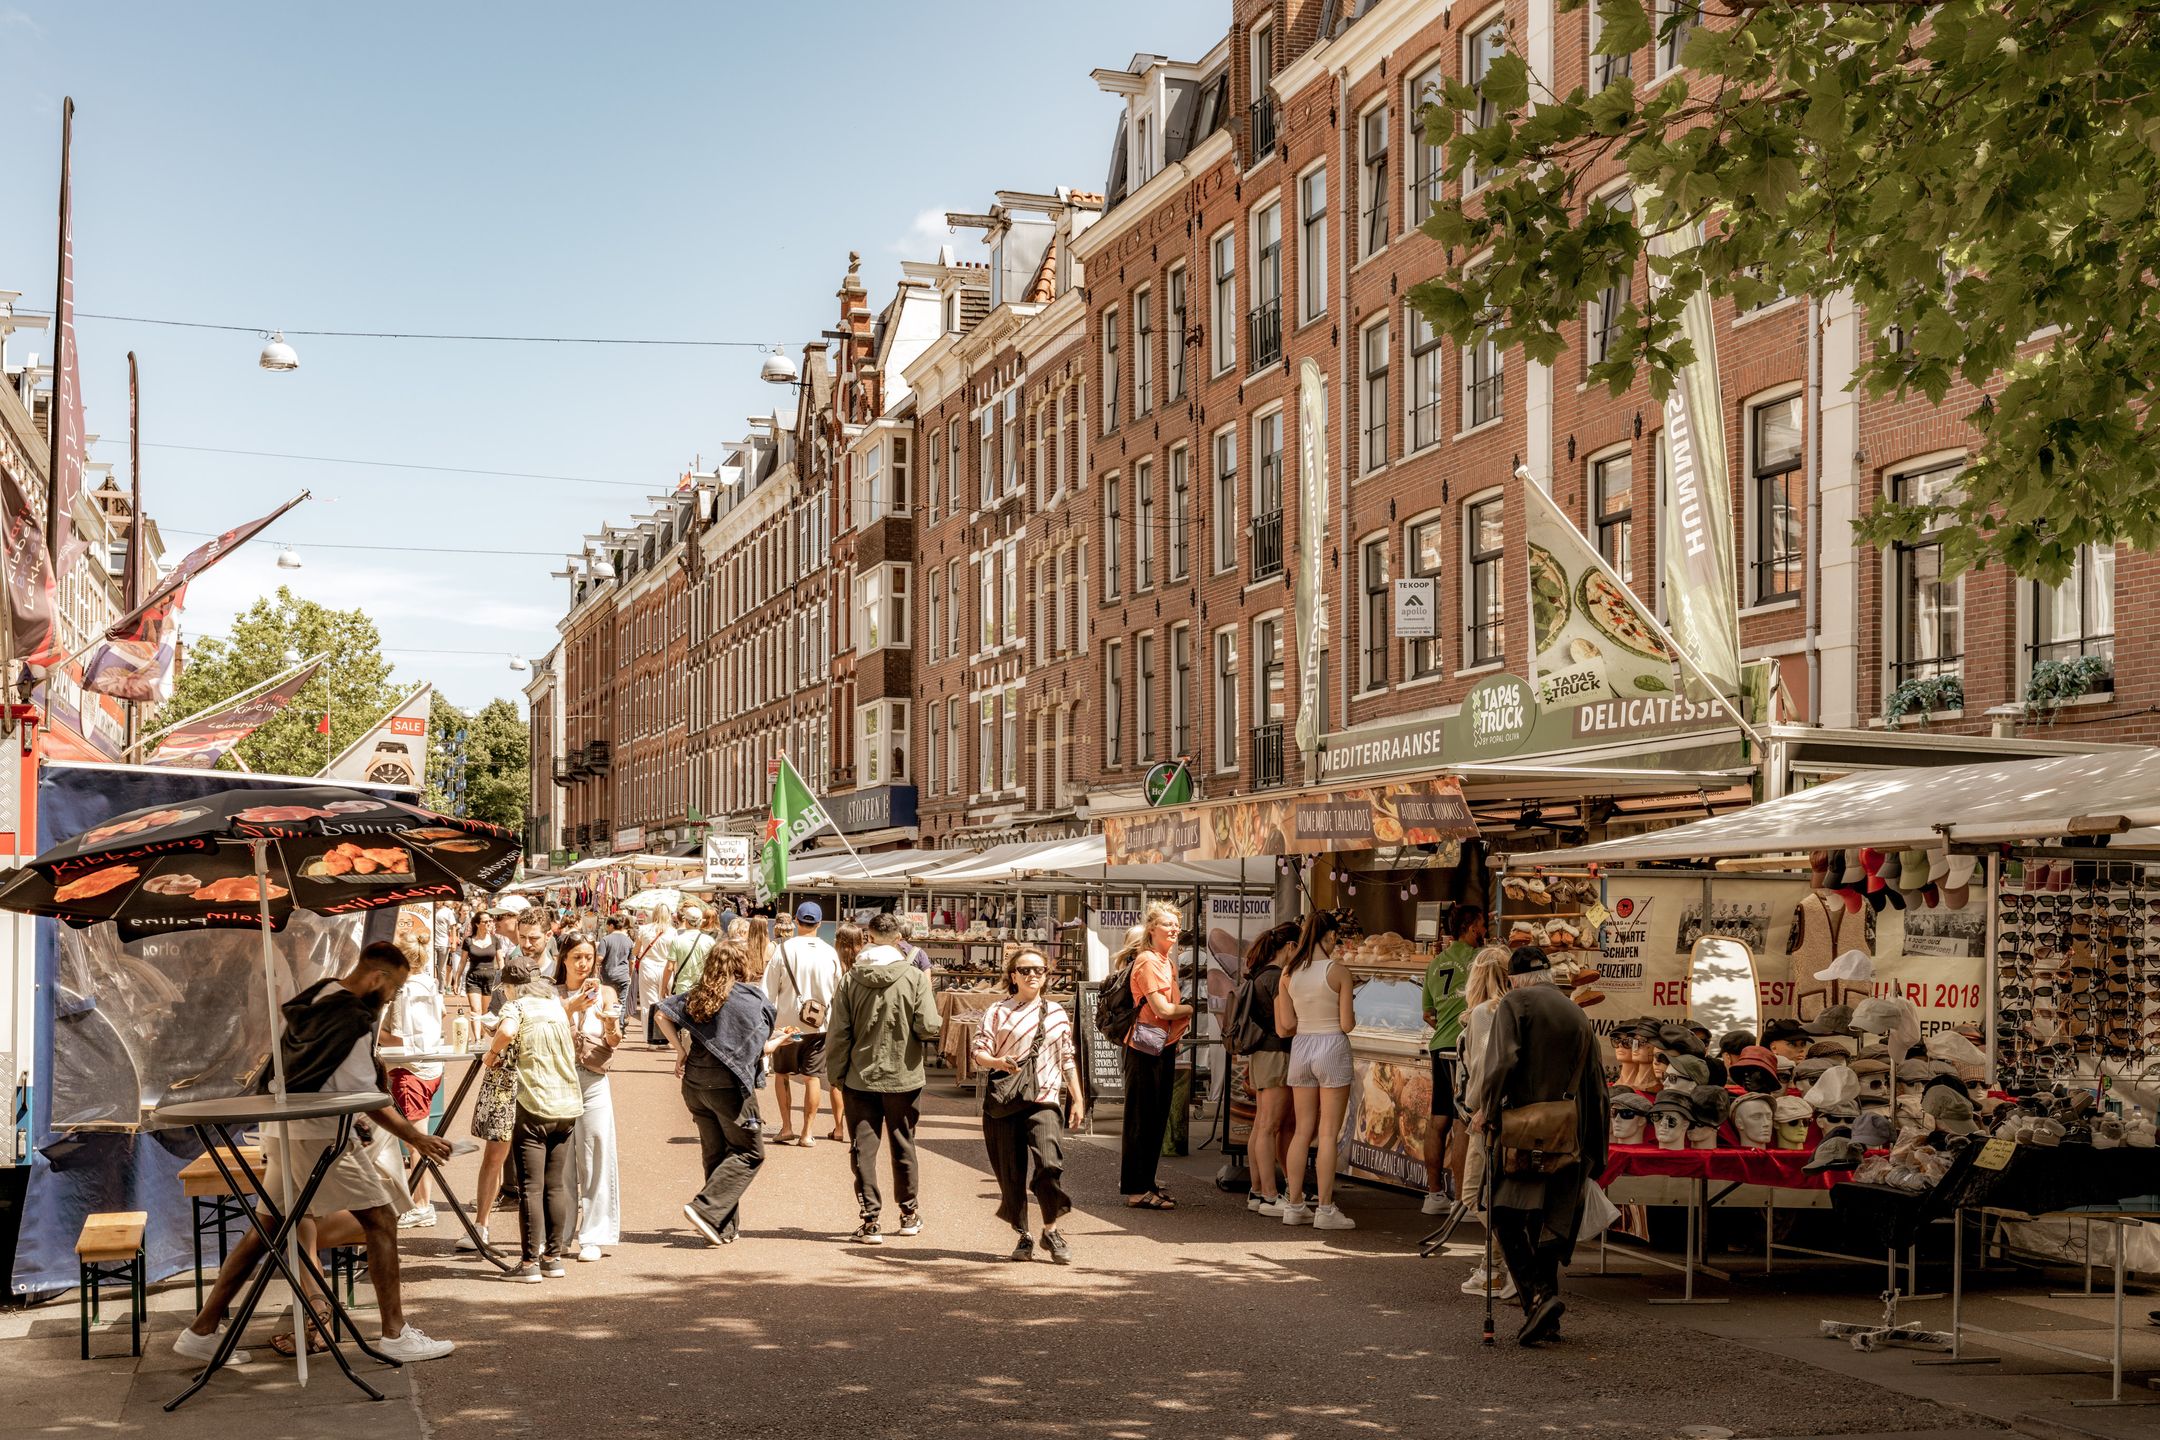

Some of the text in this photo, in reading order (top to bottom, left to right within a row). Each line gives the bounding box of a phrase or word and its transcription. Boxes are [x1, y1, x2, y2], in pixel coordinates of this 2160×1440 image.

[1401, 607, 1428, 617] apollo
[1552, 680, 1601, 699] TRUCK
[1553, 671, 1596, 687] TAPAS
[1482, 684, 1520, 711] TAPAS
[394, 720, 420, 732] SALE
[1480, 705, 1524, 734] TRUCK
[1321, 729, 1441, 772] MEDITERRAANSE
[1483, 737, 1488, 745] BY
[1298, 808, 1371, 832] HOMEMADE TAPENADES
[1401, 801, 1464, 821] AUTHENTIC HUMMUS
[1175, 825, 1199, 848] OLIVES
[50, 837, 206, 876] Kibbeling
[1603, 946, 1639, 959] SCHAPEN
[1439, 967, 1455, 995] 7
[1934, 983, 1980, 1008] 2018
[1351, 1143, 1405, 1178] MEDITERRANEAN
